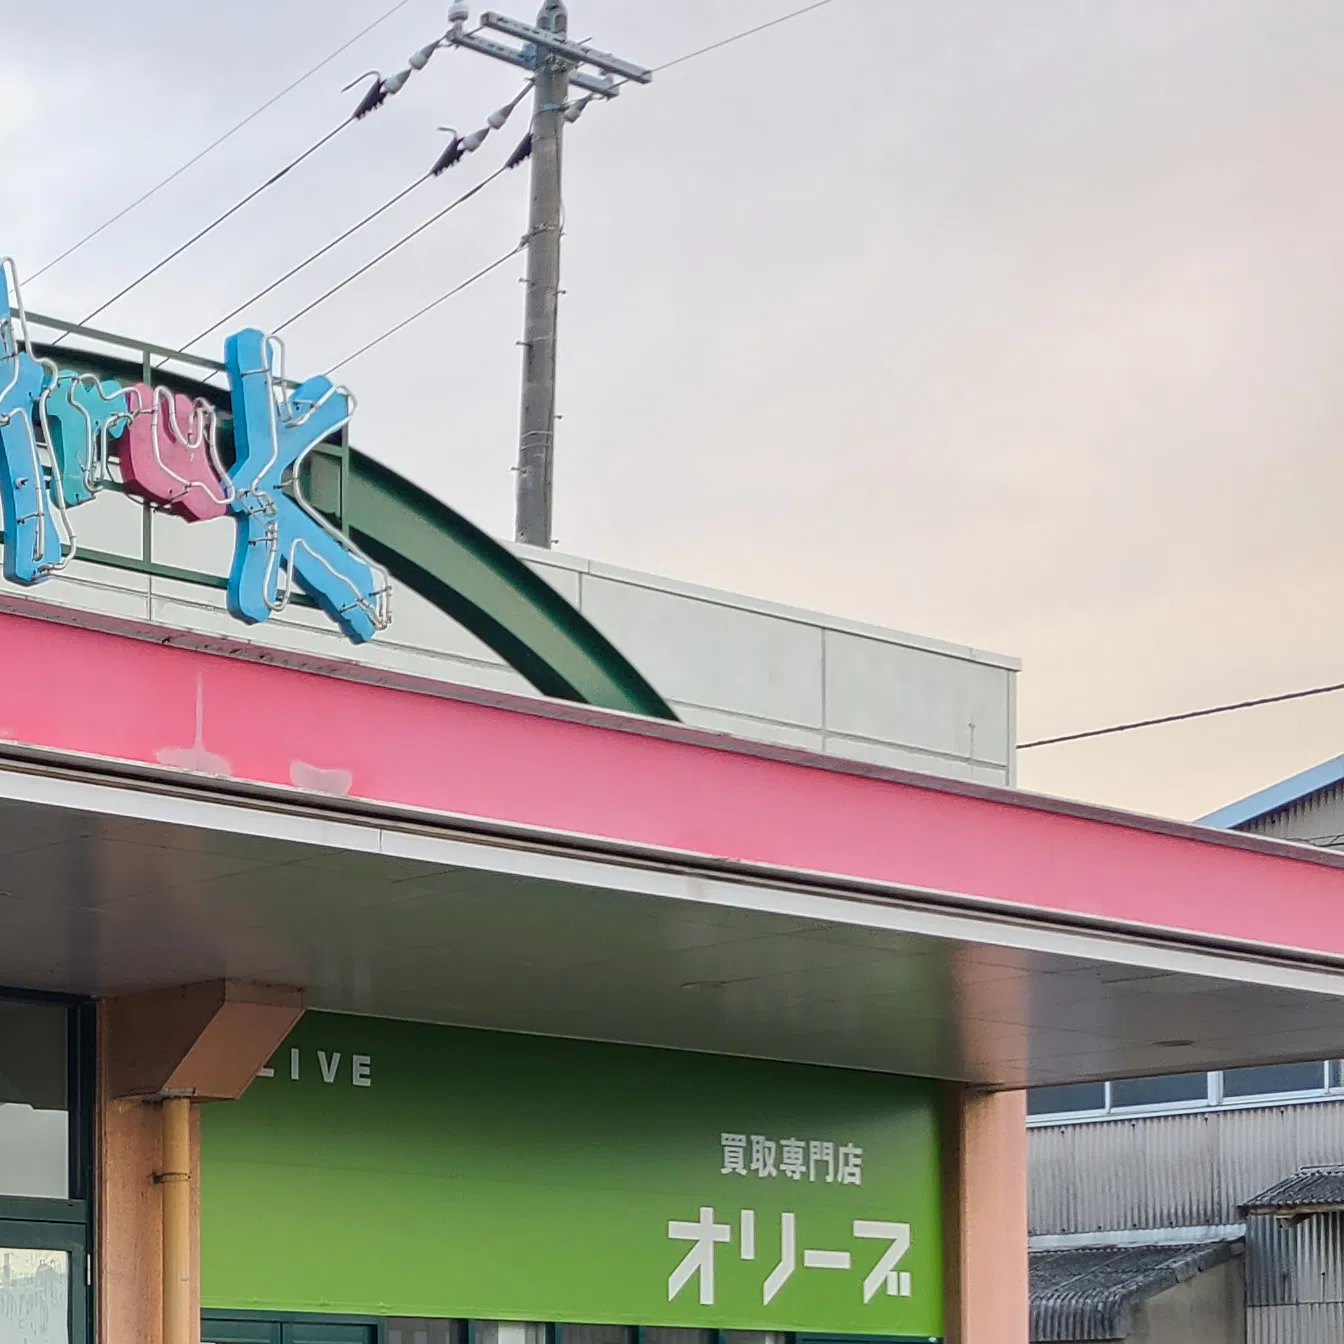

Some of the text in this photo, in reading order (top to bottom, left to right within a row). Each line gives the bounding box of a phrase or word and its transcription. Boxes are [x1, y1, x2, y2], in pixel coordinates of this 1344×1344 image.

[720, 1132, 863, 1186] 買取専門店
